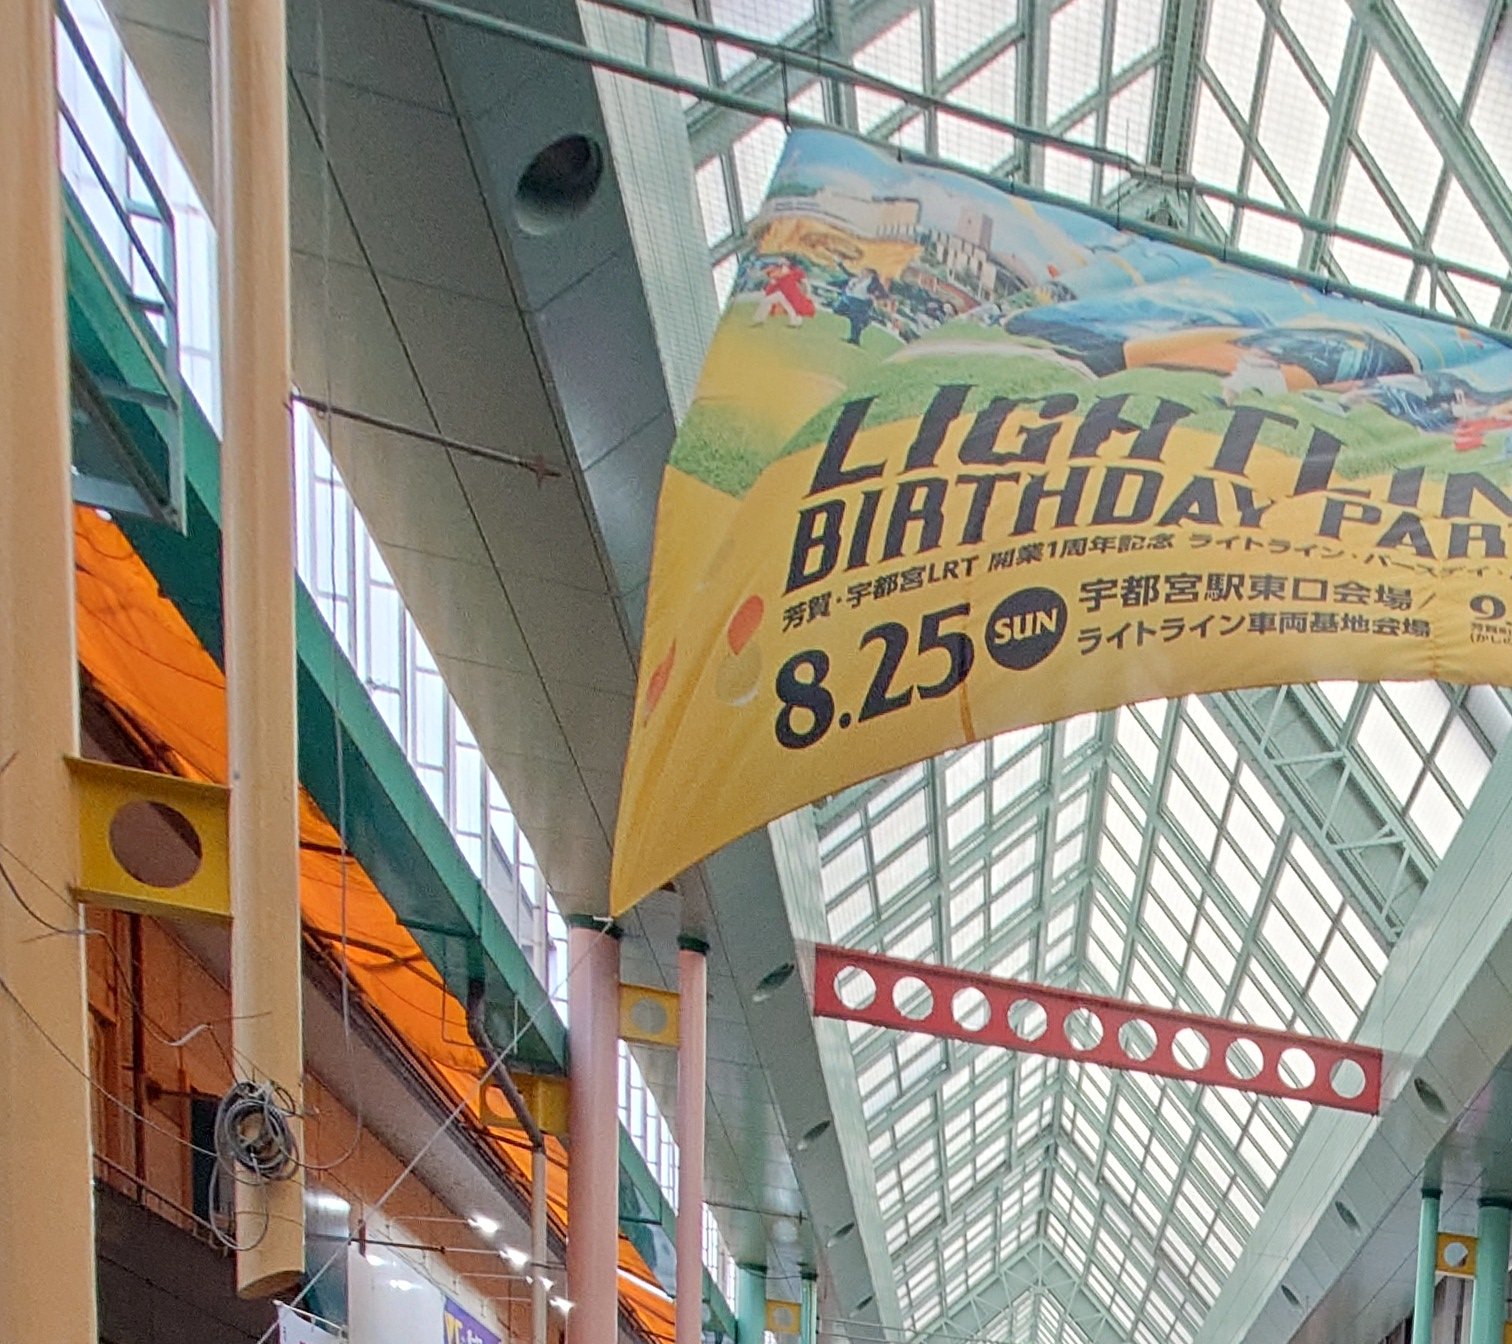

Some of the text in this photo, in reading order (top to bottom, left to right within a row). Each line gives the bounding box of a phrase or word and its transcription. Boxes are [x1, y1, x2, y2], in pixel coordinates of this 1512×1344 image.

[782, 464, 1277, 596] BIRTHDAY
[775, 603, 1060, 750] 8.25 SUN
[1078, 611, 1431, 656] ライトライン車両基地会場
